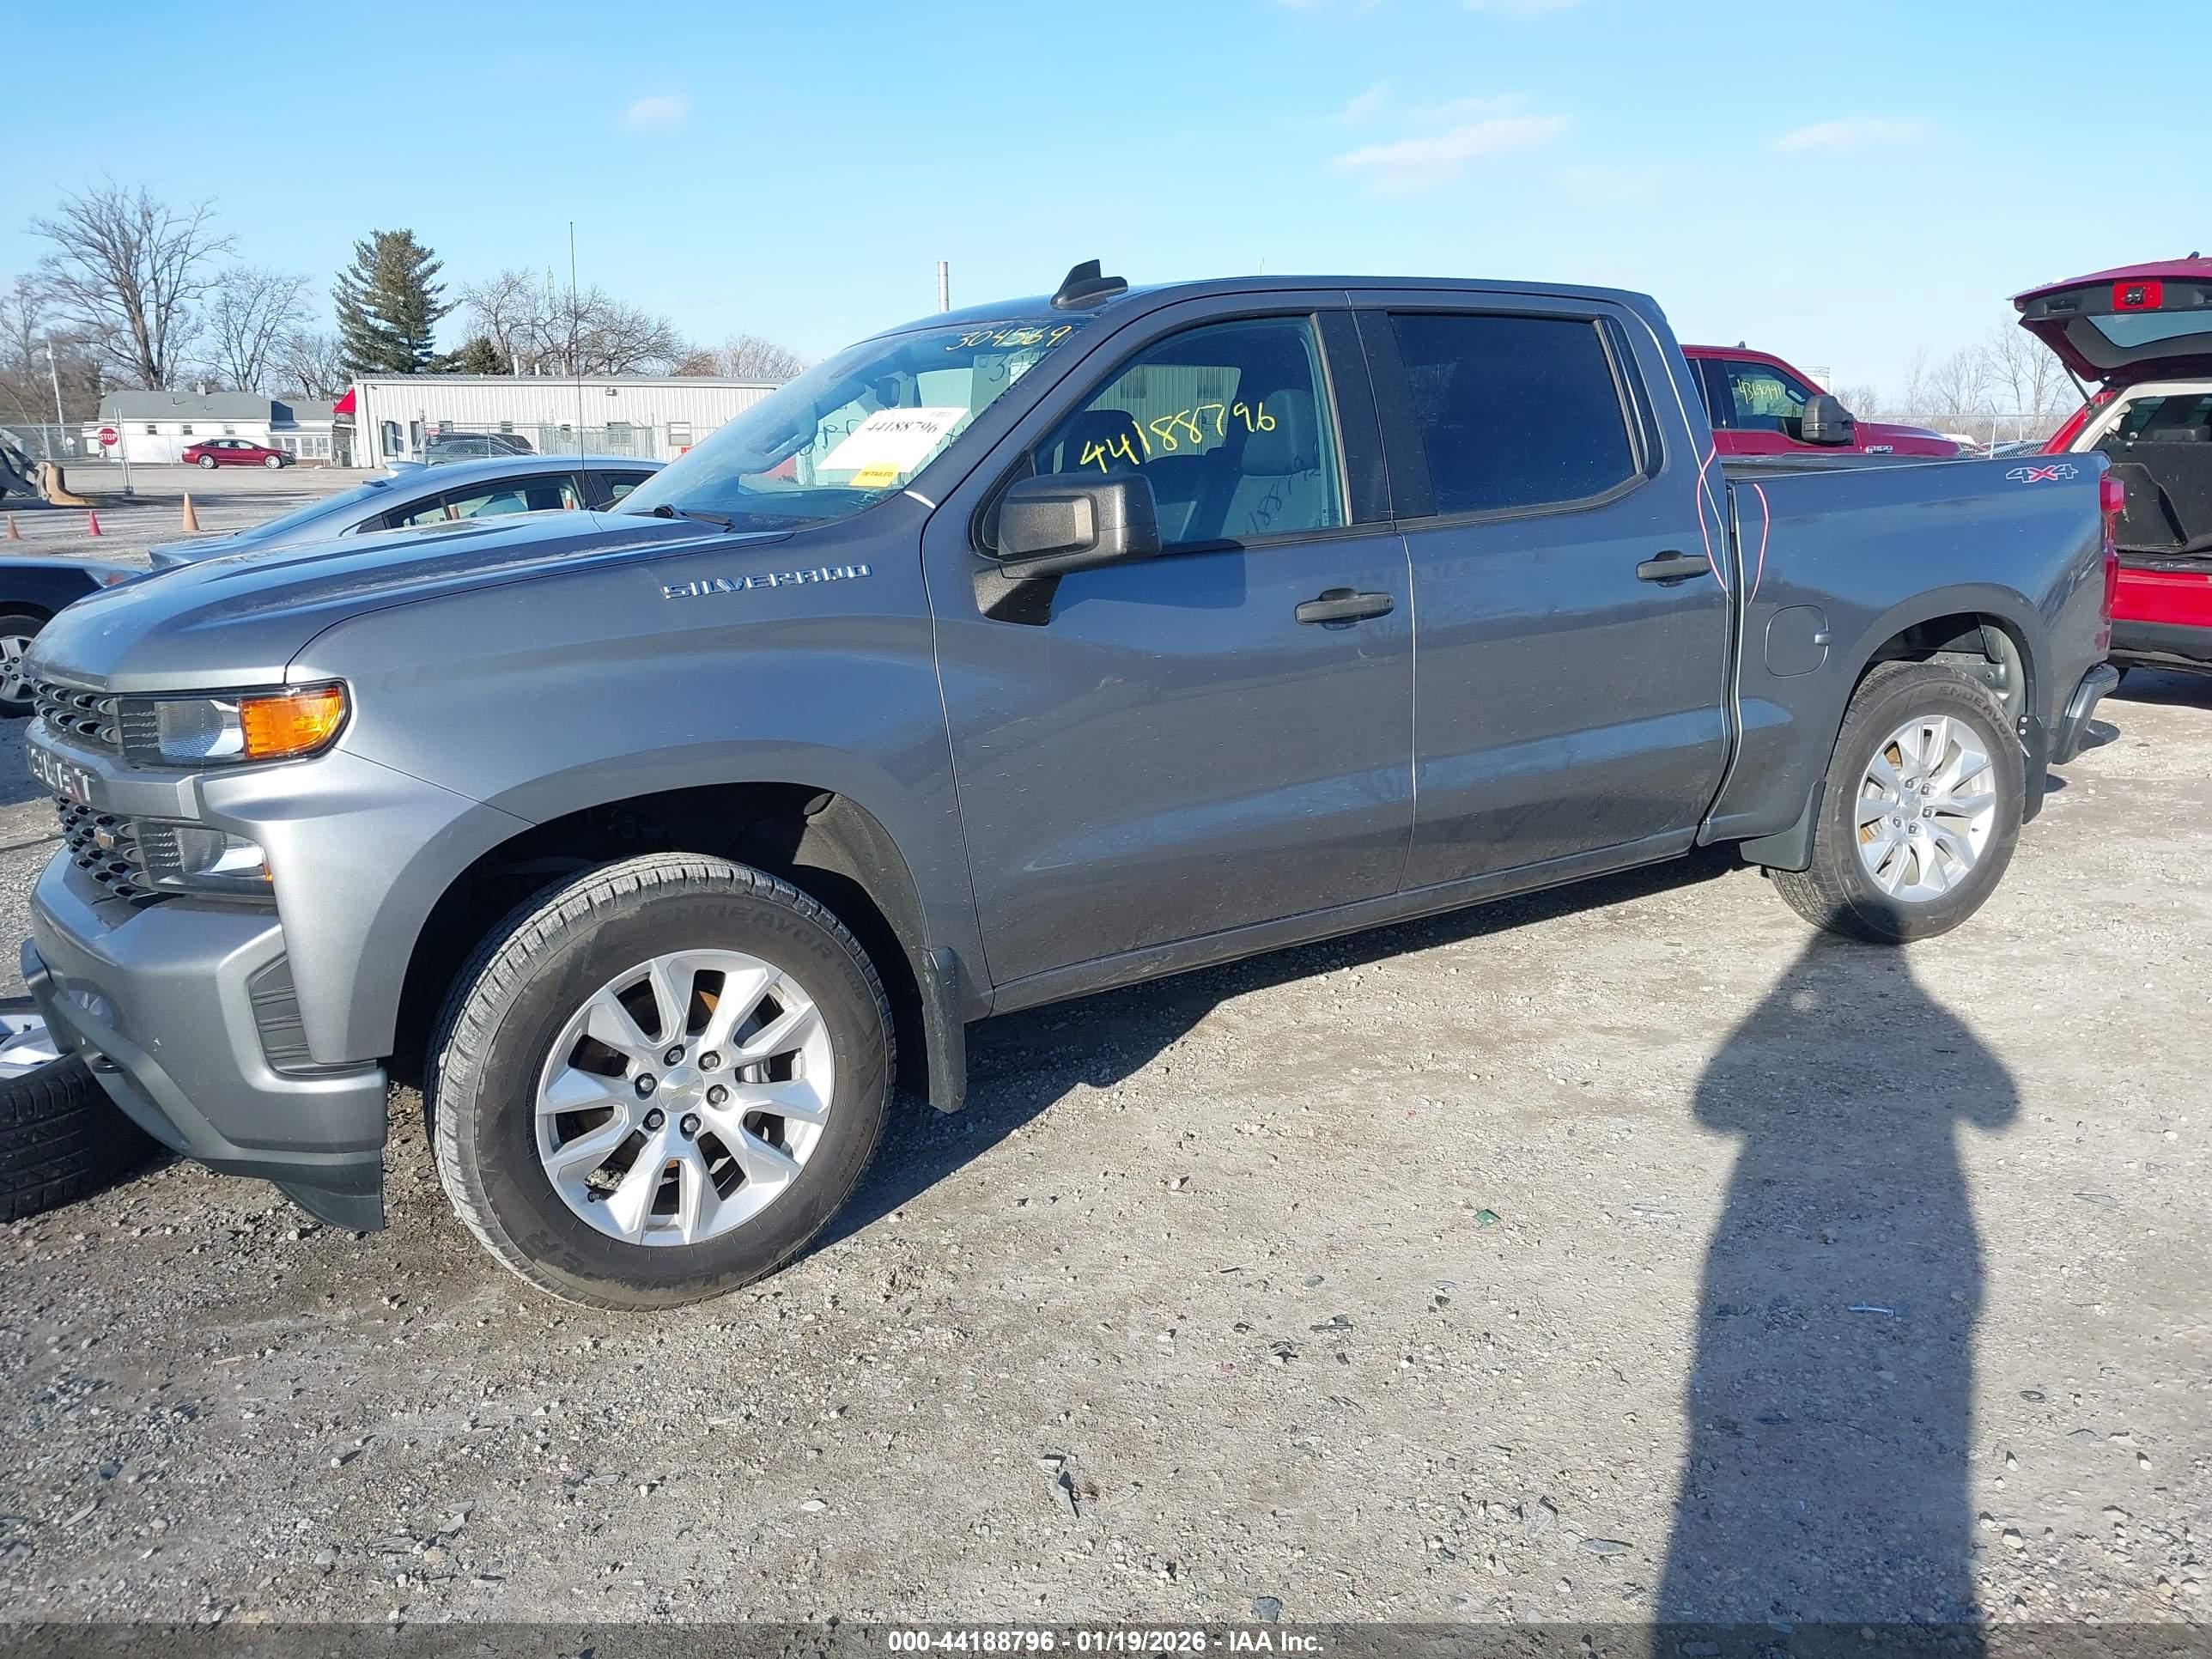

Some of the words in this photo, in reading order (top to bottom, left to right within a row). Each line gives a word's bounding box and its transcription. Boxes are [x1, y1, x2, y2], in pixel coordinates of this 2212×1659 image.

[866, 421, 939, 434] 44188796
[1079, 402, 1276, 473] 44188796
[659, 563, 873, 599] SILVERADO
